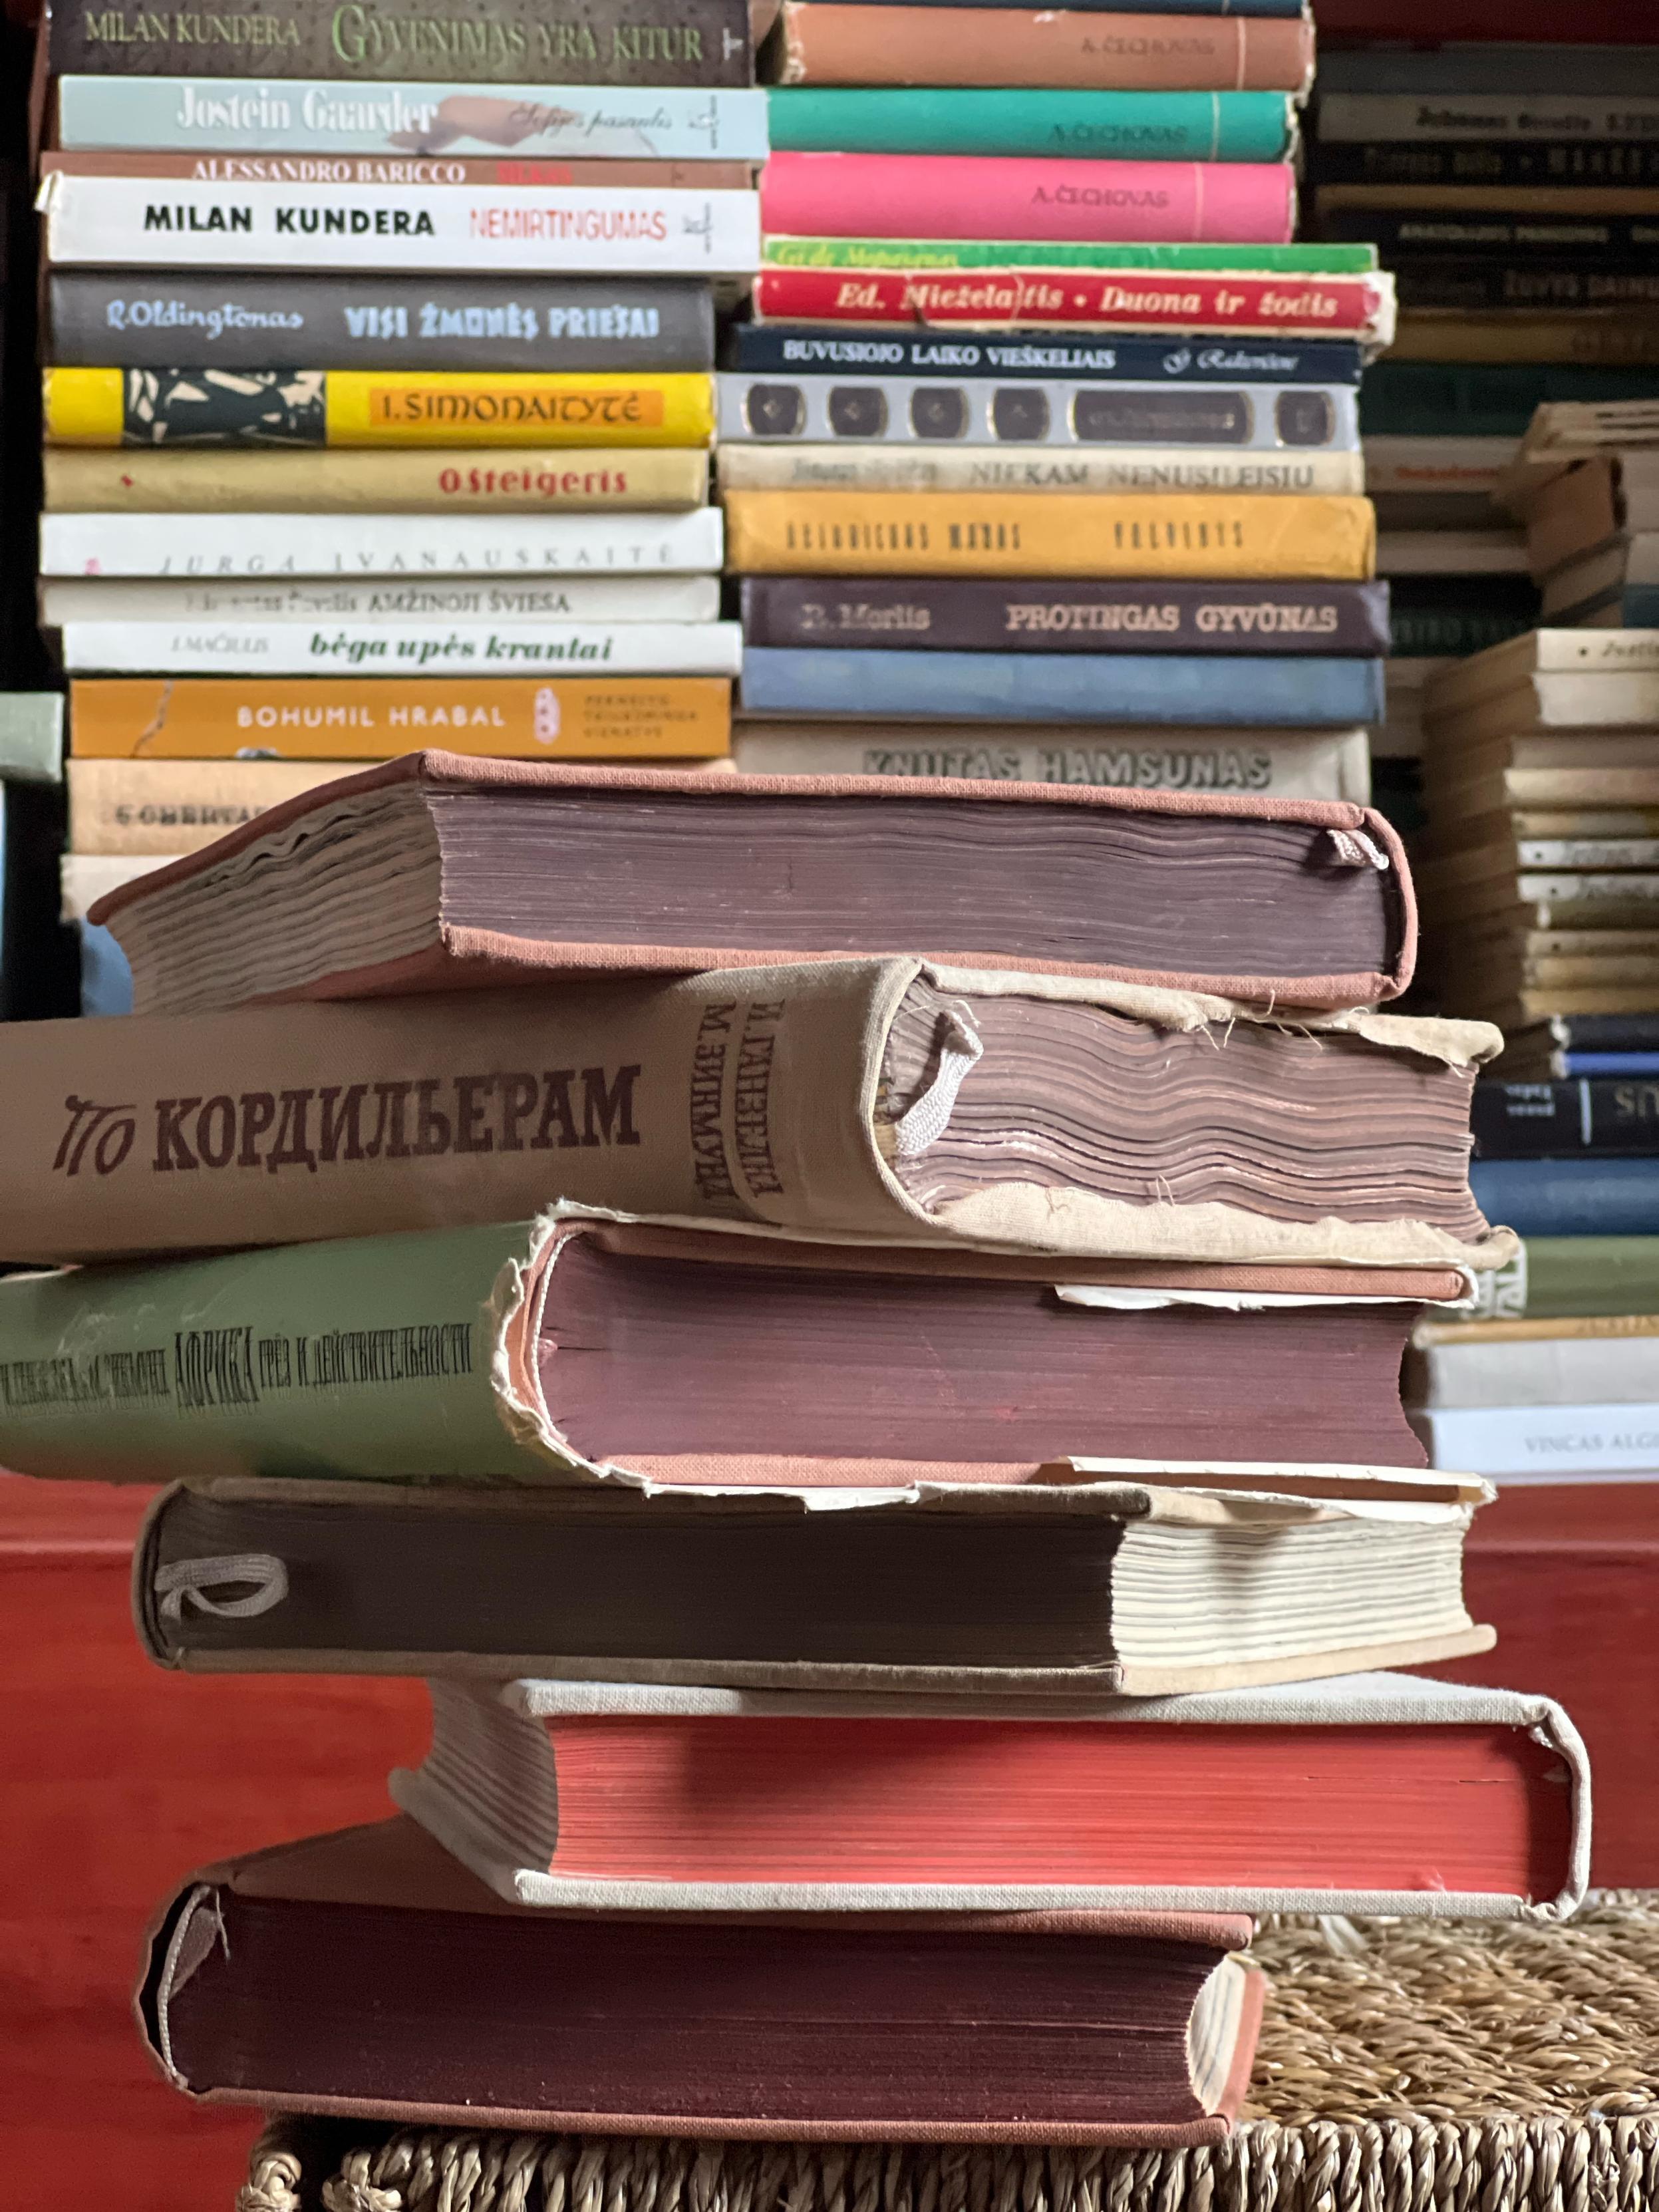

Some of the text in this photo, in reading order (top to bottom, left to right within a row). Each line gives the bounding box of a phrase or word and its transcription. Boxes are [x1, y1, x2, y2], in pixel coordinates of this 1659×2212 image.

[86, 11, 300, 45] MILAN KUNDERA
[333, 5, 702, 62] GYVENIMAS YRA KITUR
[177, 86, 438, 133] Jostein Gaarder
[192, 160, 466, 184] ALESSANDRO BARICCO
[144, 205, 435, 236] MILAN KUNDERA
[470, 209, 667, 240] NEMIRTINGUMAS
[836, 282, 886, 309] Ed.
[1100, 286, 1201, 315] Duona
[1215, 290, 1245, 315] ir
[343, 302, 659, 340] VISI ŽMONĖS PRIEŠAI
[783, 340, 903, 364] BUVUSIOJO
[911, 345, 980, 366] LAIKO
[969, 462, 1314, 488] NIEKAM NENUSILEISIU
[369, 589, 572, 613] AMŽINOJI ŠVIESA
[1006, 602, 1337, 633] PROTINGAS GYVŪNAS
[311, 632, 612, 664] bėga upės krantai
[237, 706, 506, 726] BOHUMIL HRABAL
[1038, 748, 1272, 789] HAMSUNAS
[153, 1065, 641, 1174] КОРДИЛЬЕРАМ
[174, 1325, 260, 1408] АФРИКА
[313, 1323, 473, 1386] ДЕЙСТВИТЕЛЬНОСТИ
[1524, 1432, 1604, 1454] VINCAS
